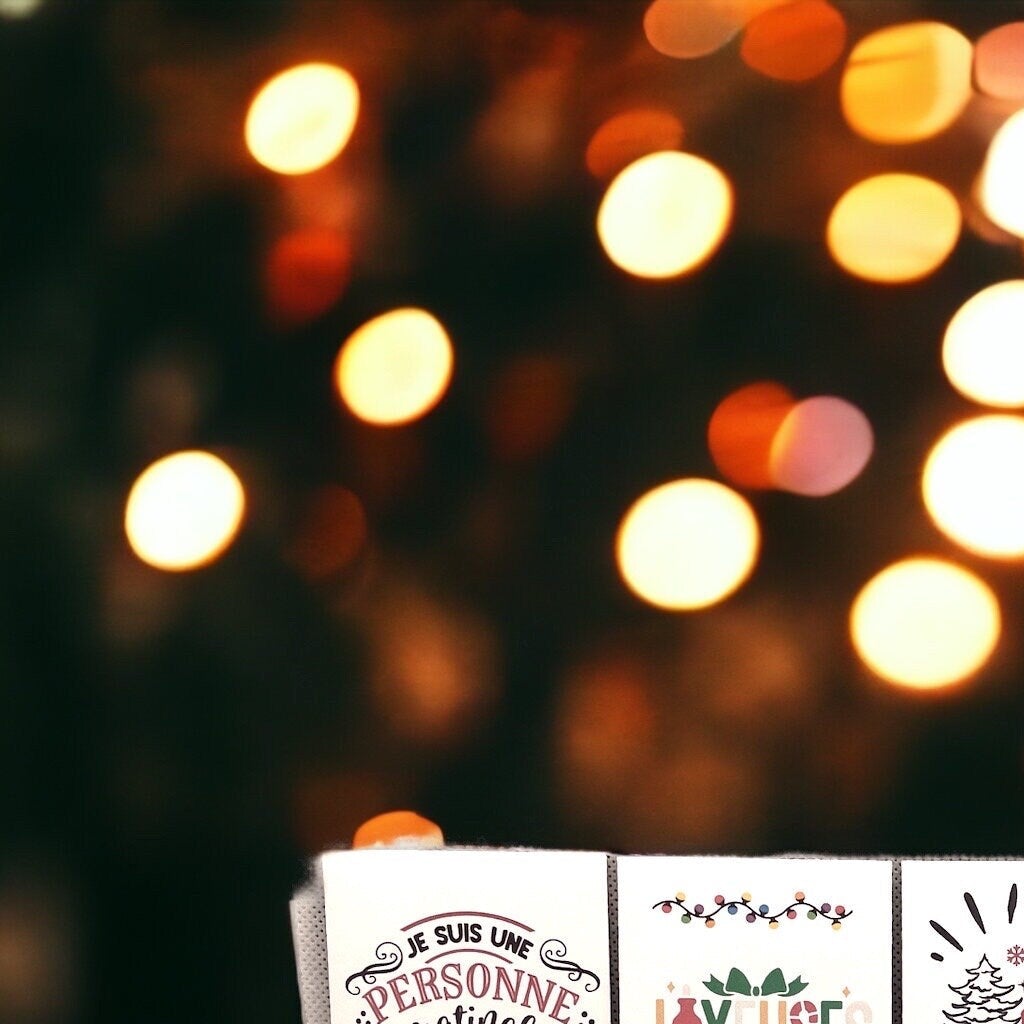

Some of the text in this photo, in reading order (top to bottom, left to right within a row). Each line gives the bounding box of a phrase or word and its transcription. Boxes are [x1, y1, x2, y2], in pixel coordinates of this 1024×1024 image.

[407, 923, 534, 959] JE SUIS UNE
